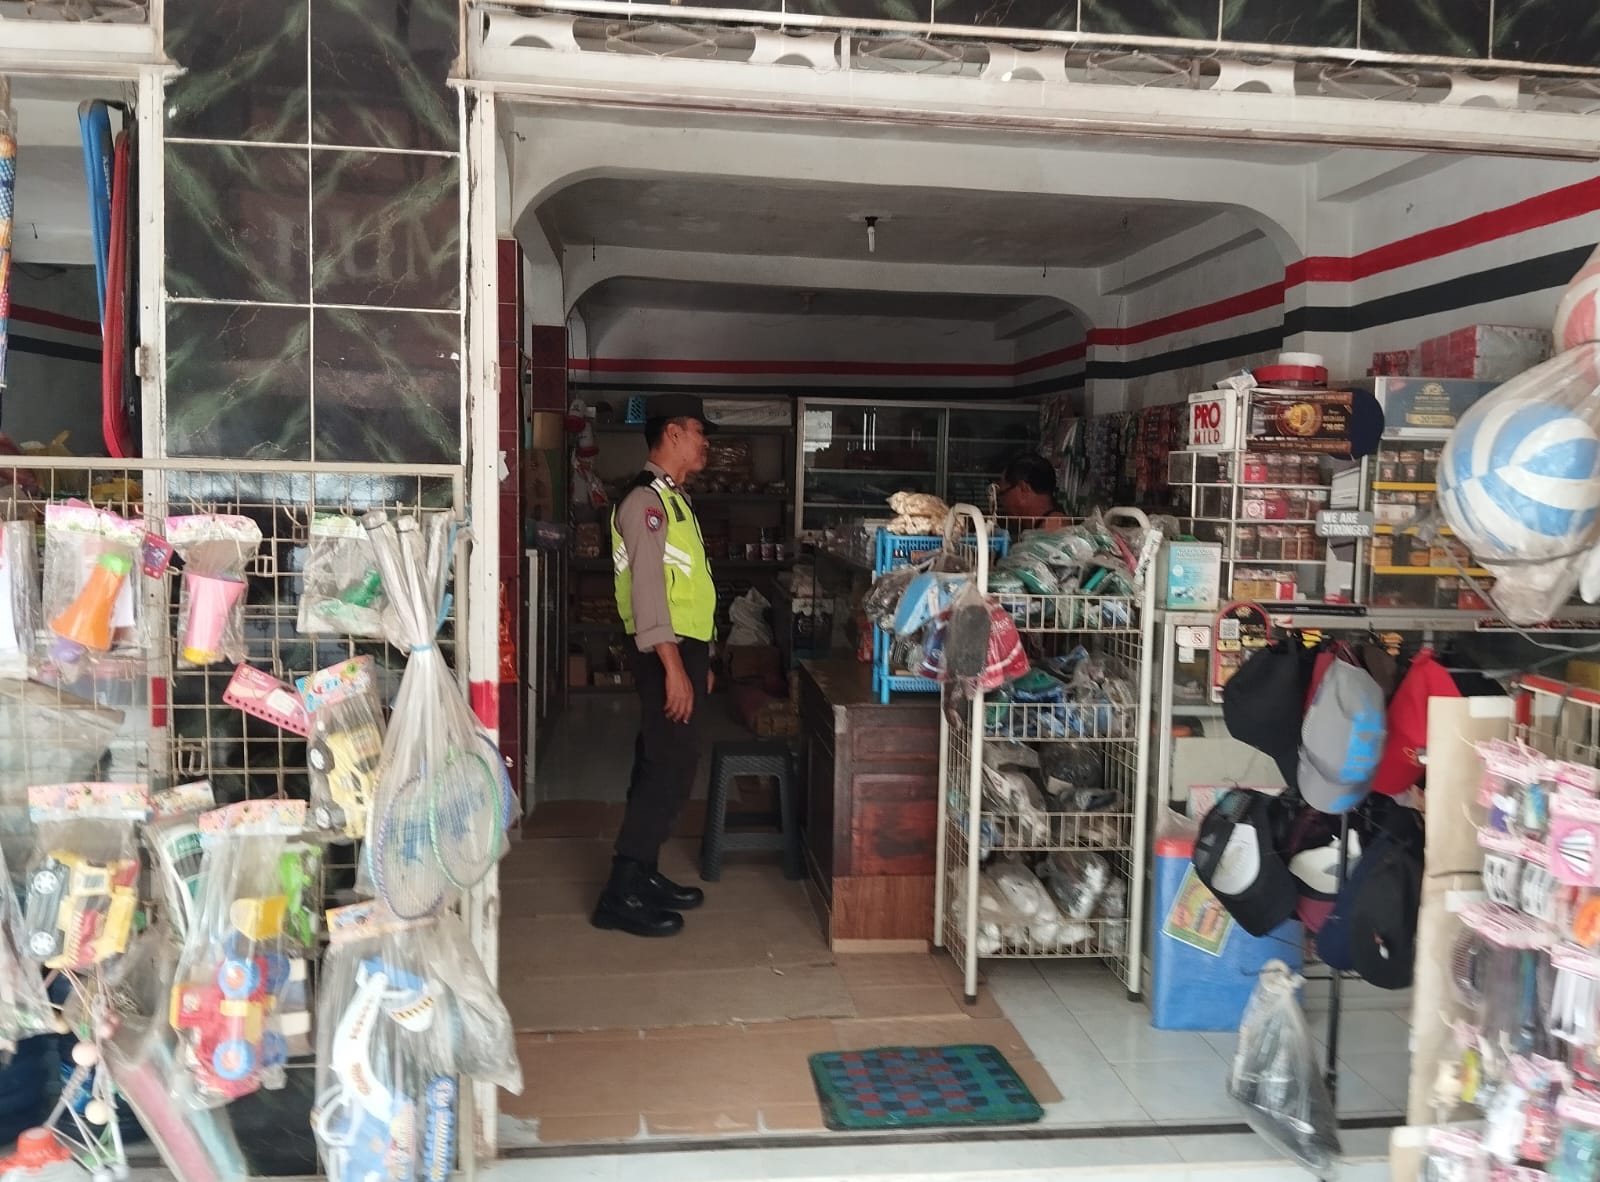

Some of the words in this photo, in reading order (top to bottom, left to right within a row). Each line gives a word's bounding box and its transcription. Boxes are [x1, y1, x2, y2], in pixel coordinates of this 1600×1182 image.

[1194, 402, 1221, 429] PRO
[1194, 429, 1220, 445] MILD
[1323, 511, 1337, 523] WE
[1339, 512, 1358, 524] ARE
[1321, 524, 1369, 536] STRONGER
